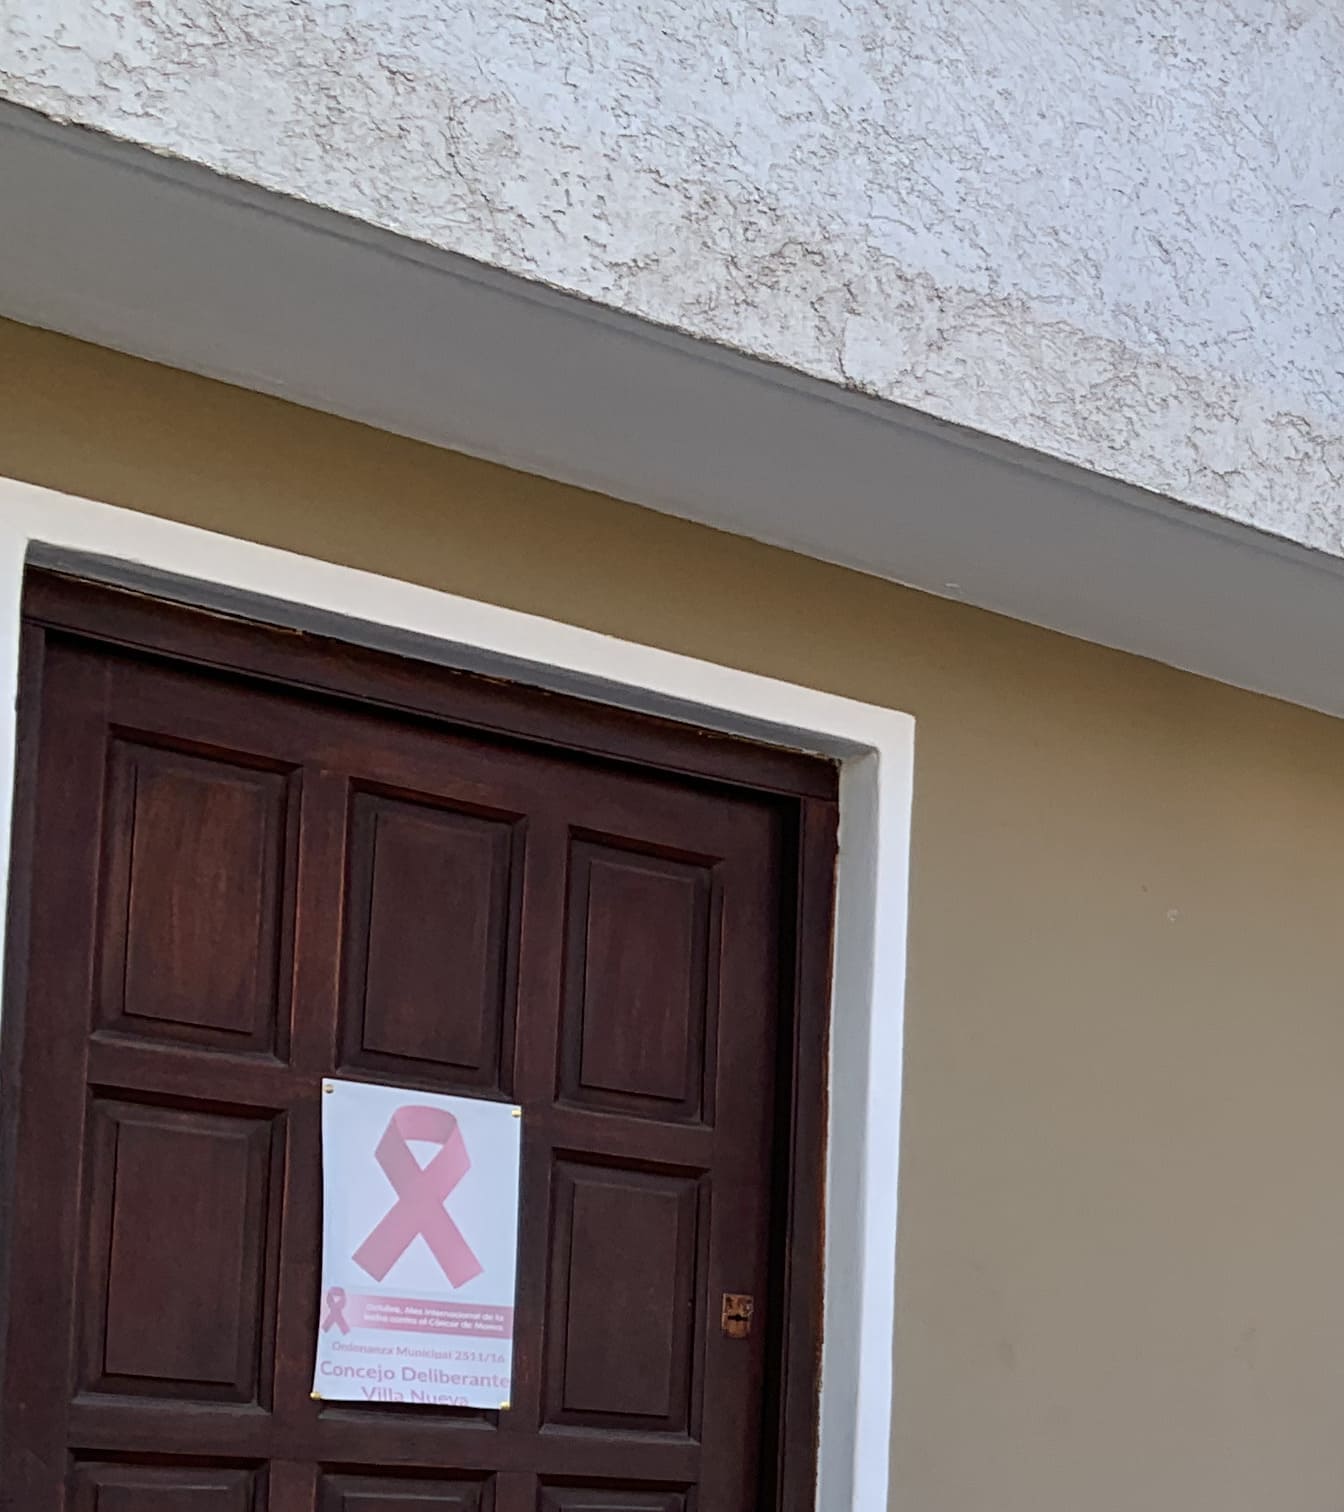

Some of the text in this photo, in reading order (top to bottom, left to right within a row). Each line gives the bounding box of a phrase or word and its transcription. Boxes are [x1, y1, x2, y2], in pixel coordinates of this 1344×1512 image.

[332, 1341, 394, 1355] Ordenanza
[396, 1346, 452, 1361] Municipal
[320, 1360, 510, 1389] Concejo Deliberante
[361, 1385, 404, 1401] Villa
